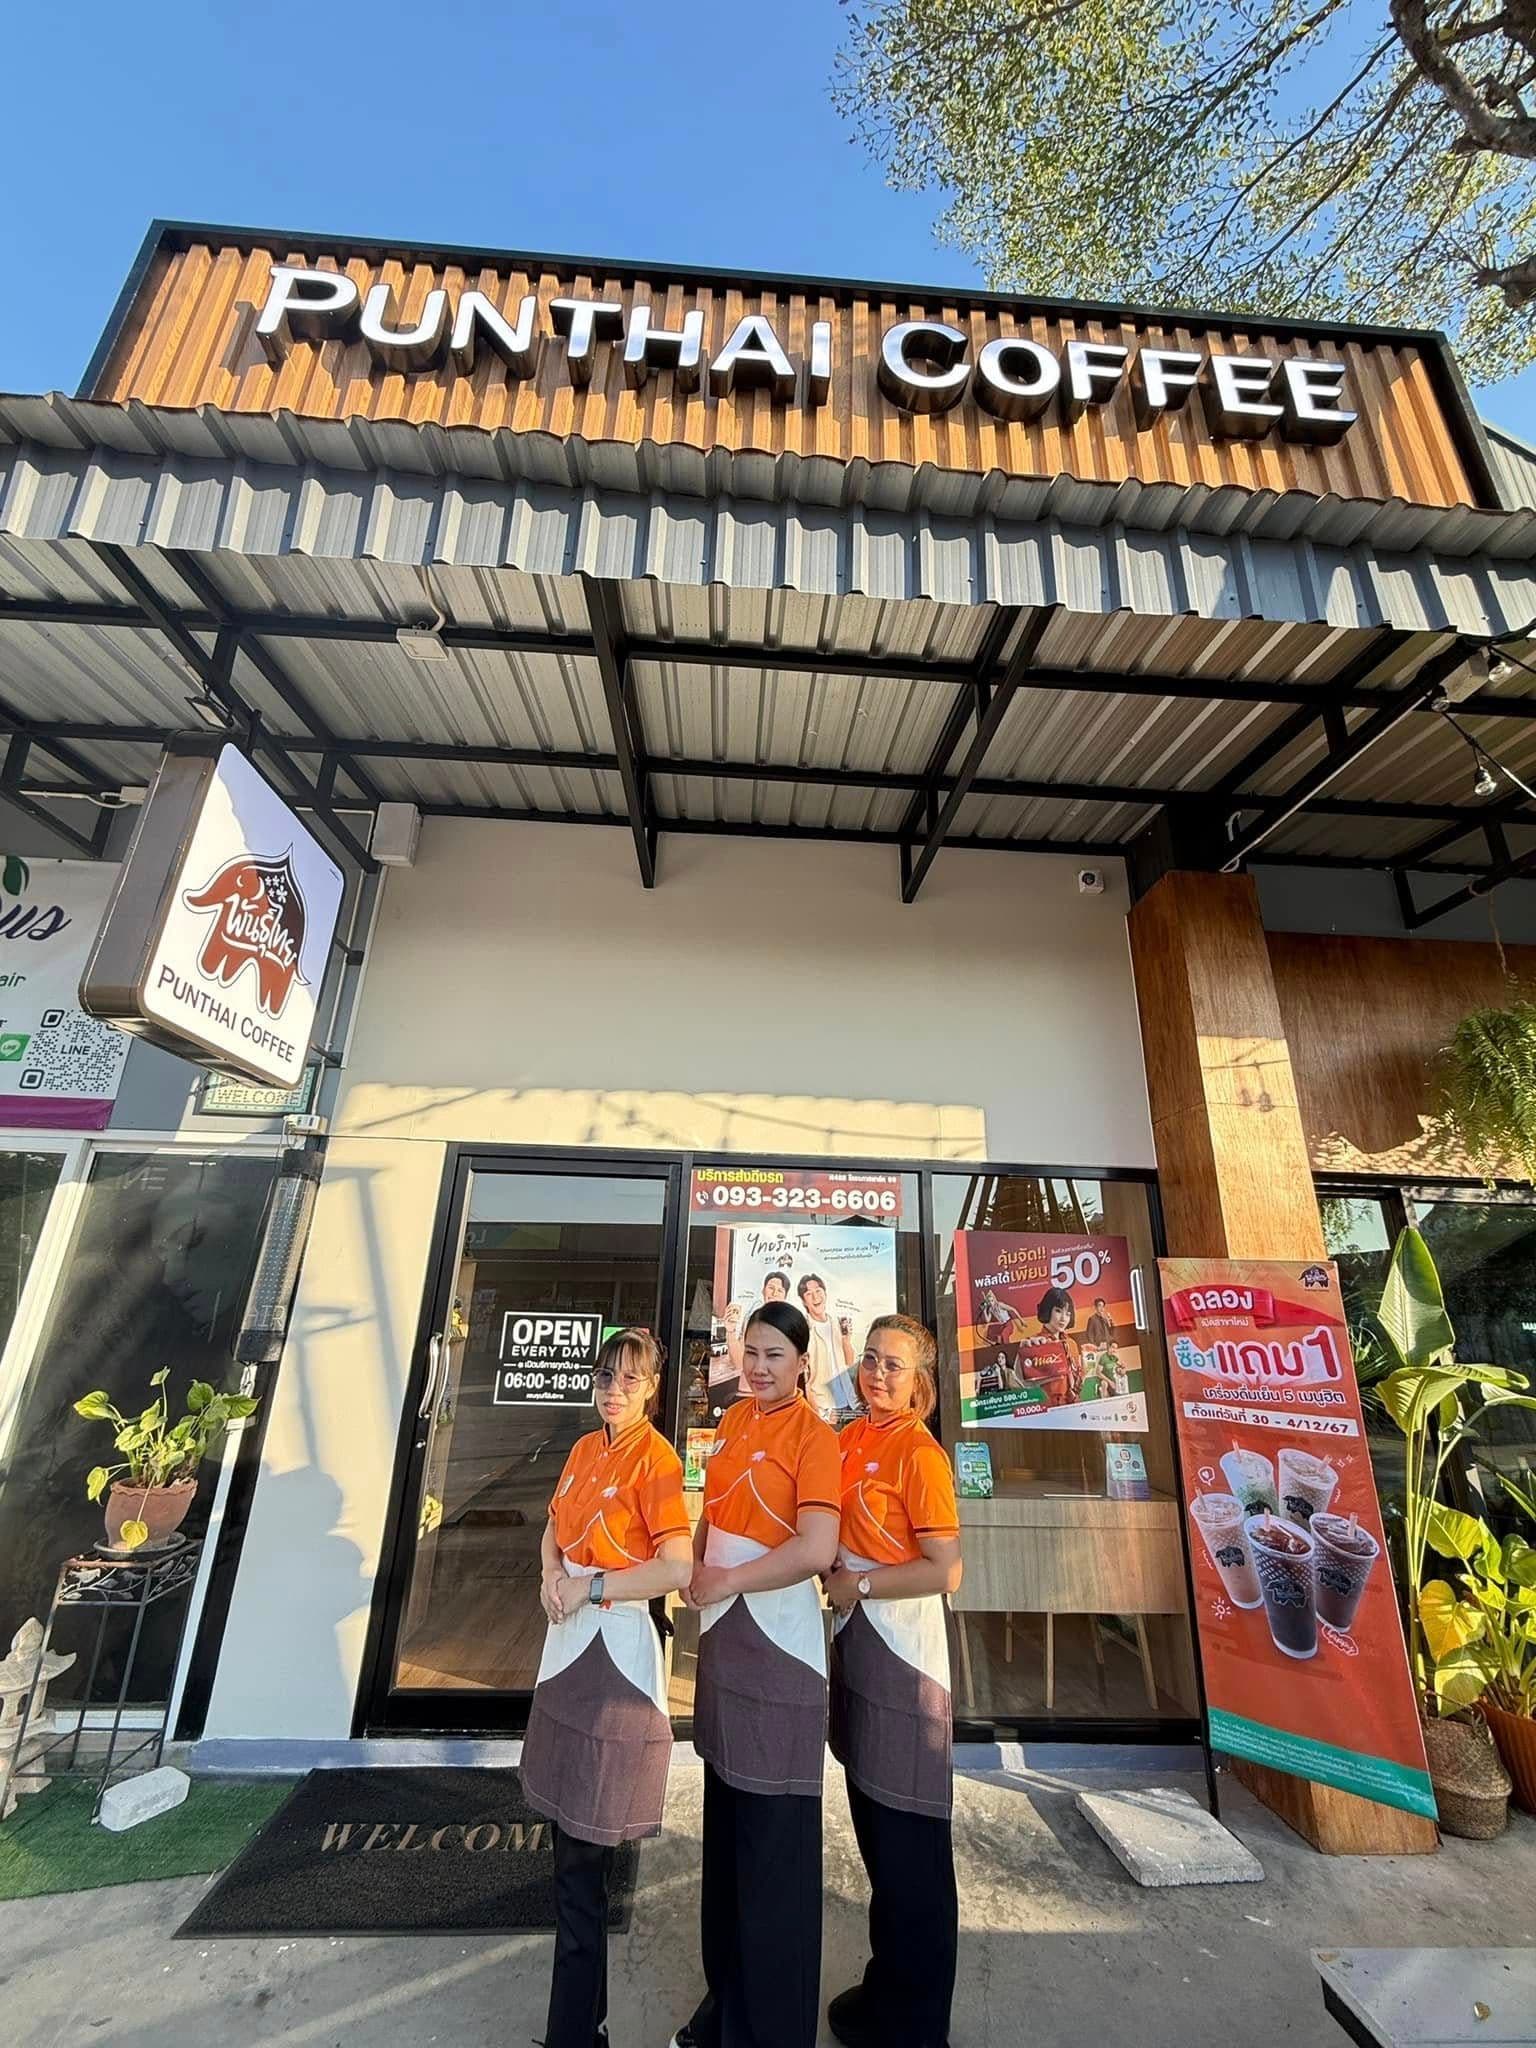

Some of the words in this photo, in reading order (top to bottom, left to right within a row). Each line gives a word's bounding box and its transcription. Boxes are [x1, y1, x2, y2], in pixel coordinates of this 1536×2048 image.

[255, 265, 831, 383] PUNTHAI
[880, 320, 1358, 426] COFFEE
[0, 902, 72, 941] us
[157, 964, 238, 1031] PUNTHAI
[240, 1016, 295, 1063] COFFEE
[60, 1043, 91, 1056] LINE
[217, 1089, 301, 1105] WELCOME
[712, 1185, 897, 1211] 093-323-6606
[1050, 1249, 1111, 1290] 50%
[1189, 1289, 1254, 1311] ฉลอง
[512, 1318, 592, 1346] OPEN
[511, 1345, 557, 1357] EVERY
[561, 1346, 590, 1358] DAY
[503, 1372, 590, 1390] 06:00-18:00
[1204, 1384, 1280, 1403] เครื่องดื่มเย็น
[1284, 1390, 1294, 1402] 5
[1299, 1390, 1345, 1407] เมนูฮิต
[1191, 1402, 1248, 1423] ตั้งแต่วันที่
[1252, 1414, 1269, 1425] 30
[1287, 1418, 1349, 1434] 4/12/67
[319, 1822, 553, 1853] WELCOM
